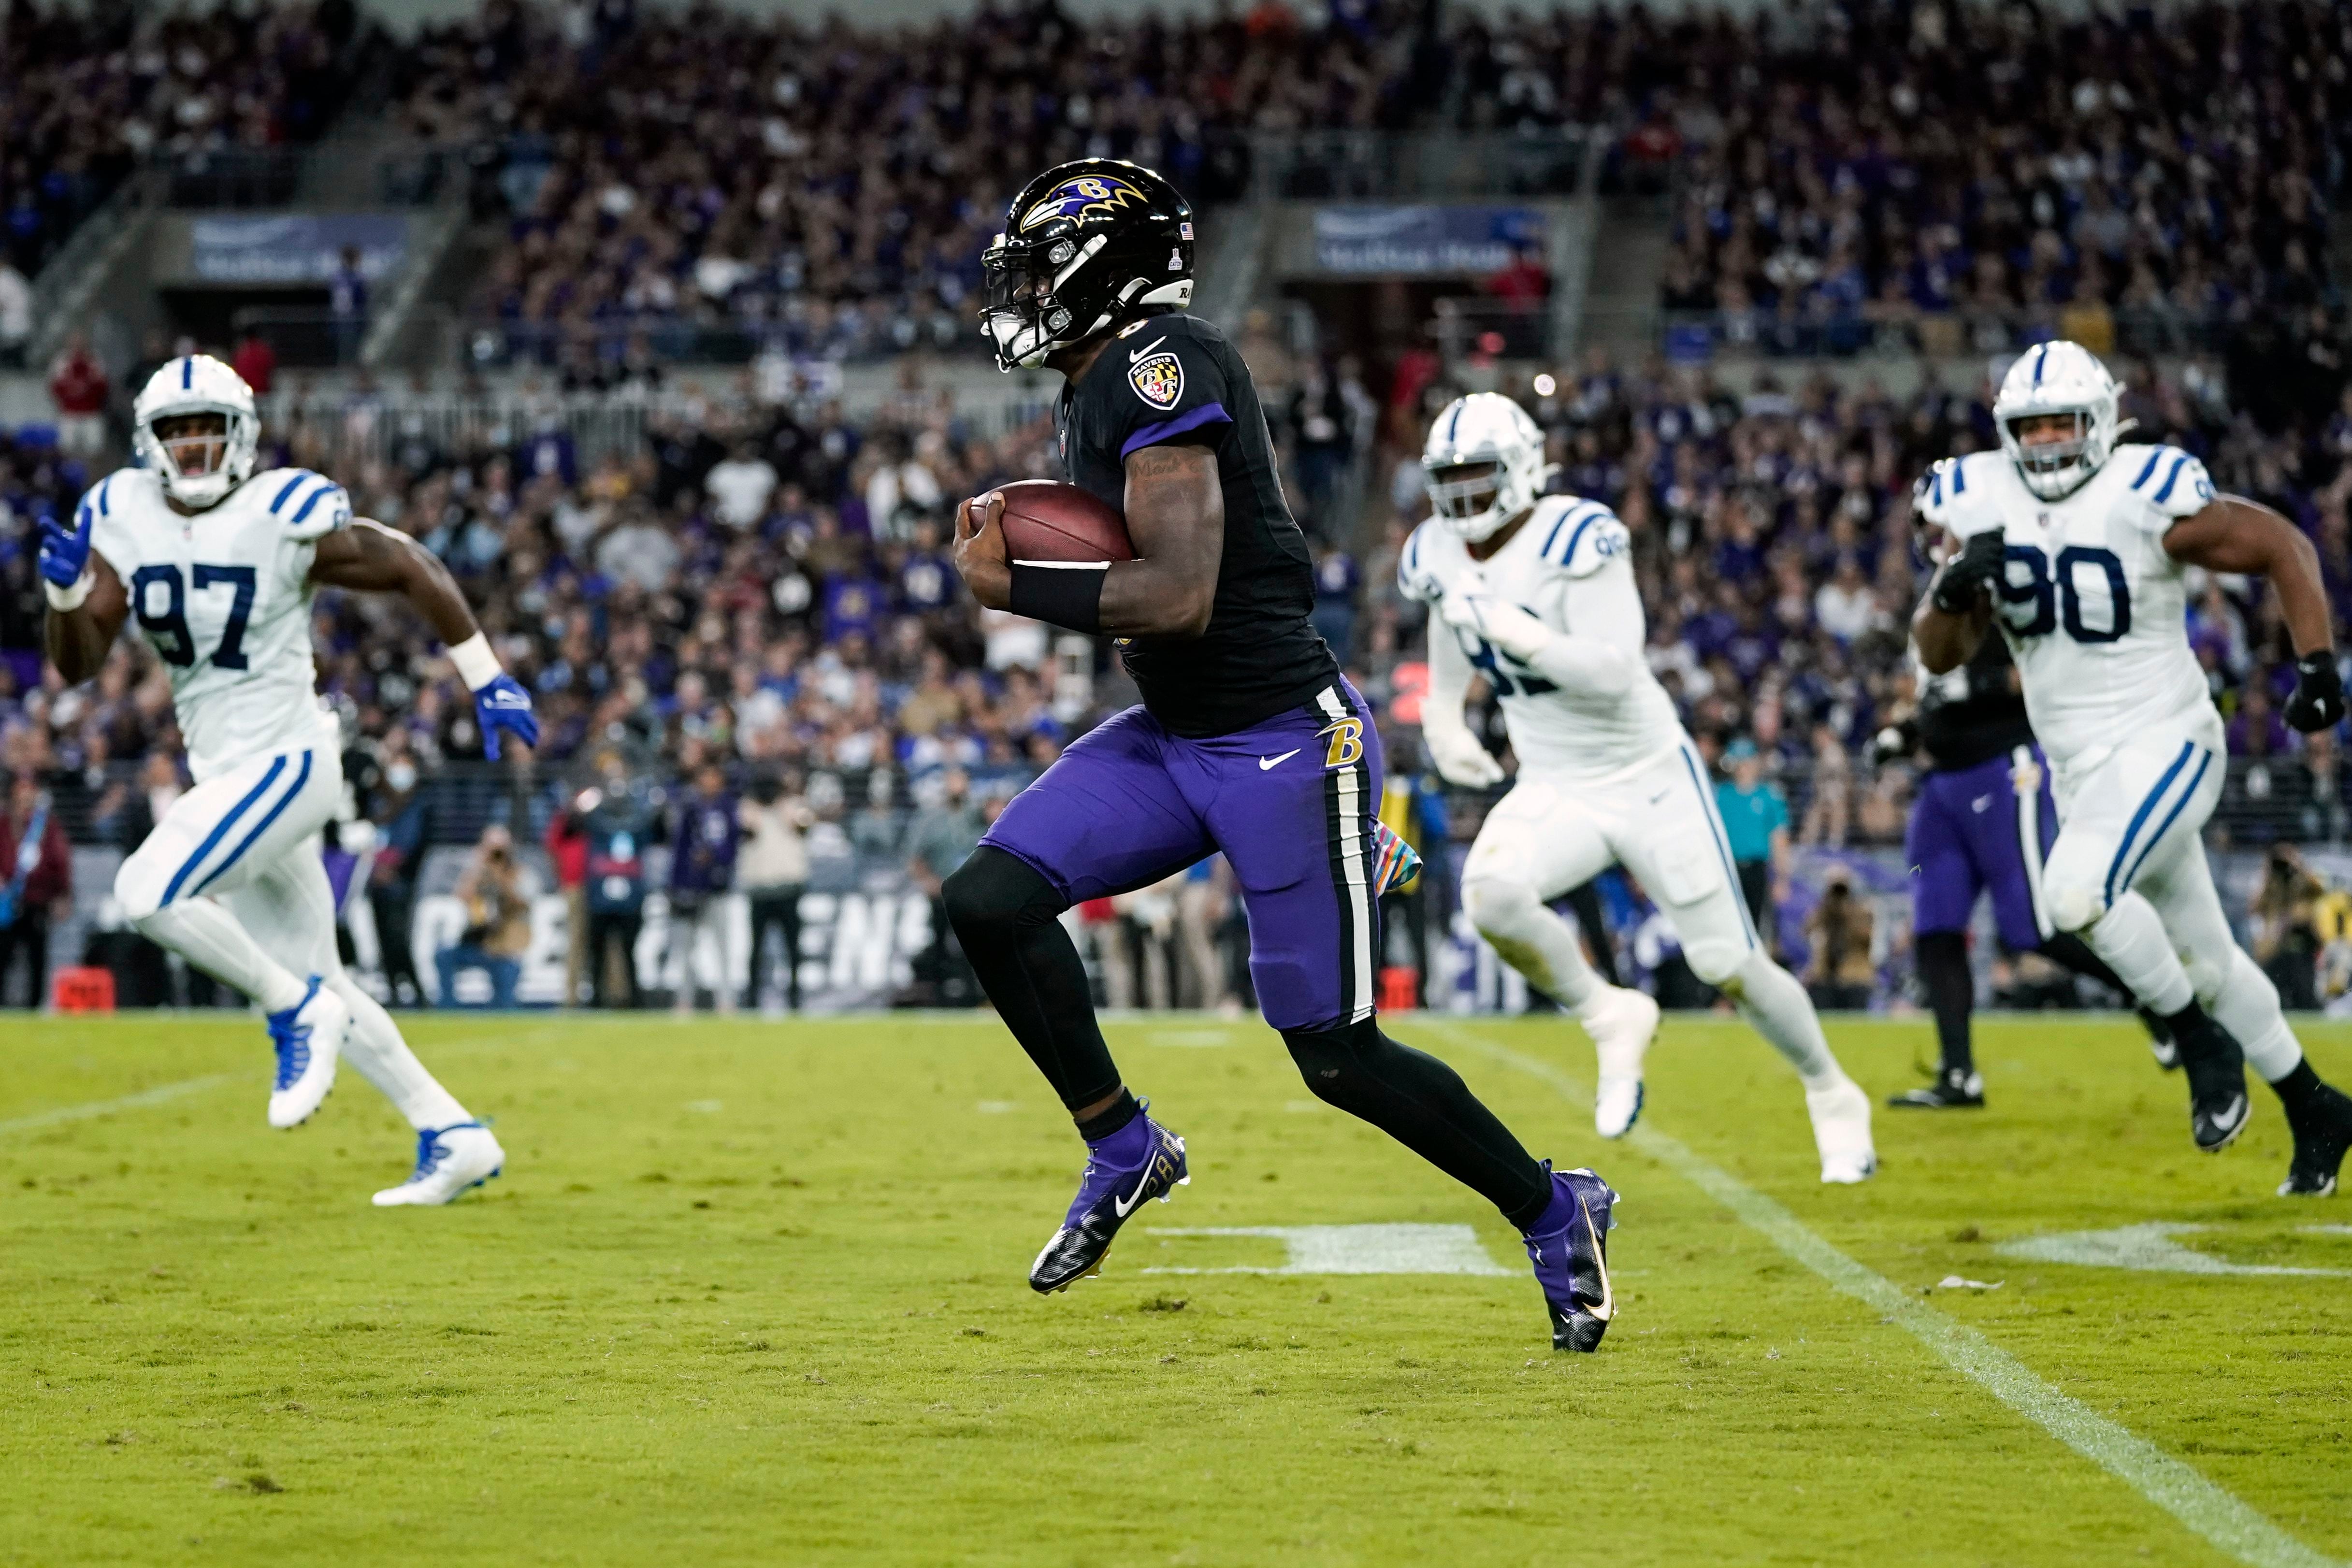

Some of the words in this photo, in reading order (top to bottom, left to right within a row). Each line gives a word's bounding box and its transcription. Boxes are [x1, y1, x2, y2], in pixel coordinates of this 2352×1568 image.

[1132, 357, 1171, 376] RAVENS
[130, 563, 256, 671] 97
[2000, 545, 2131, 643] 90
[1314, 717, 1364, 768] B
